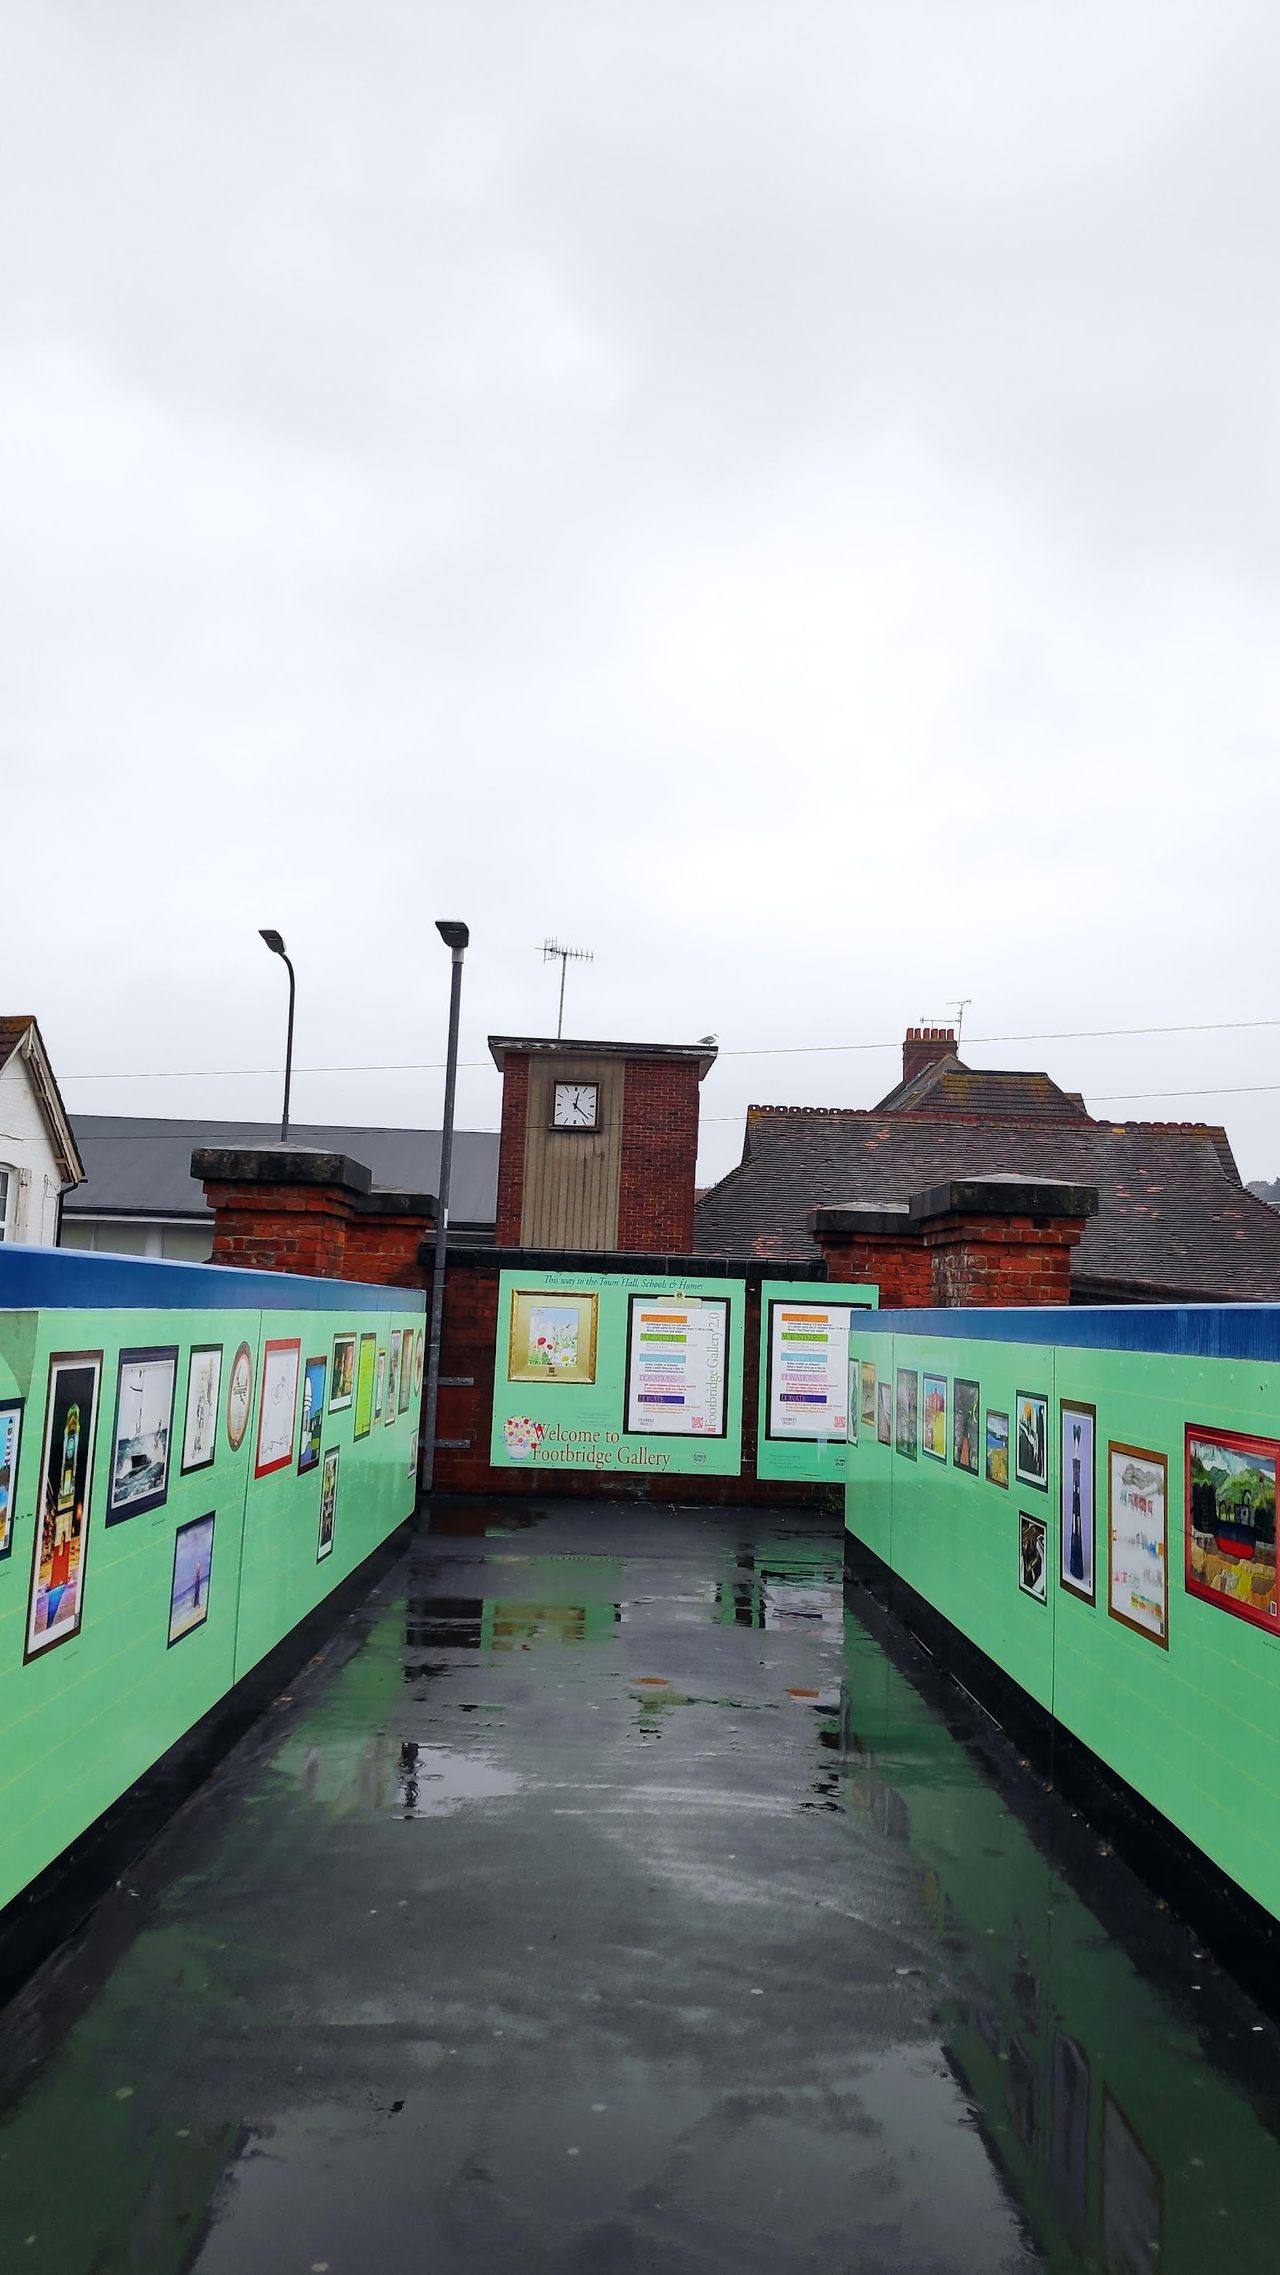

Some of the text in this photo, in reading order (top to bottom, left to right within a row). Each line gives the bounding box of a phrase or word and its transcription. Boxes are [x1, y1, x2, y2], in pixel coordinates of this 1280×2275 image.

[544, 1275, 704, 1290] This way to the Town Hall, Schools & Homes
[706, 1331, 724, 1368] Gallery
[781, 1374, 817, 1382] DONATIONS
[705, 1370, 723, 1428] Footbridge
[533, 1423, 620, 1443] Welcome to
[531, 1443, 671, 1471] Footbridge Gallery
